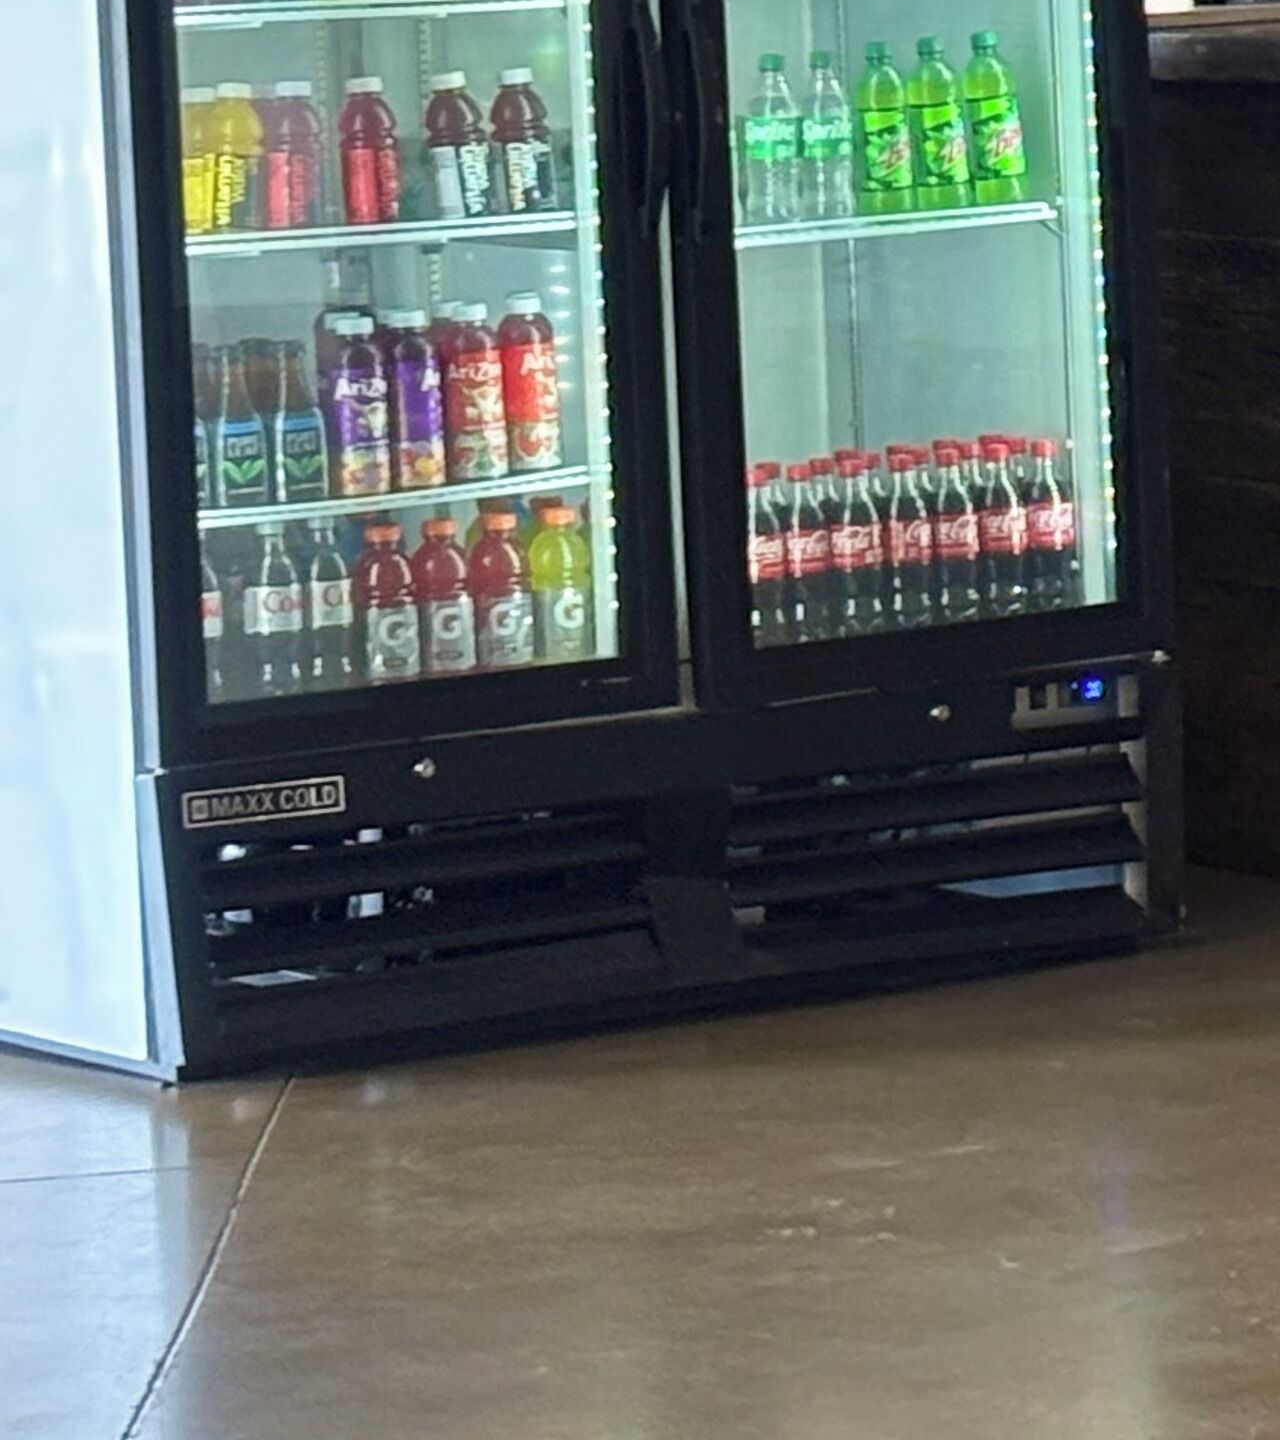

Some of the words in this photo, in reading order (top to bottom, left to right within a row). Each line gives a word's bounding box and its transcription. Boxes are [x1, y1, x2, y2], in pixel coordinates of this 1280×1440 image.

[432, 607, 463, 640] G
[489, 602, 517, 636] G
[553, 593, 584, 629] G
[211, 790, 276, 818] MAXX
[279, 785, 337, 810] COLD
